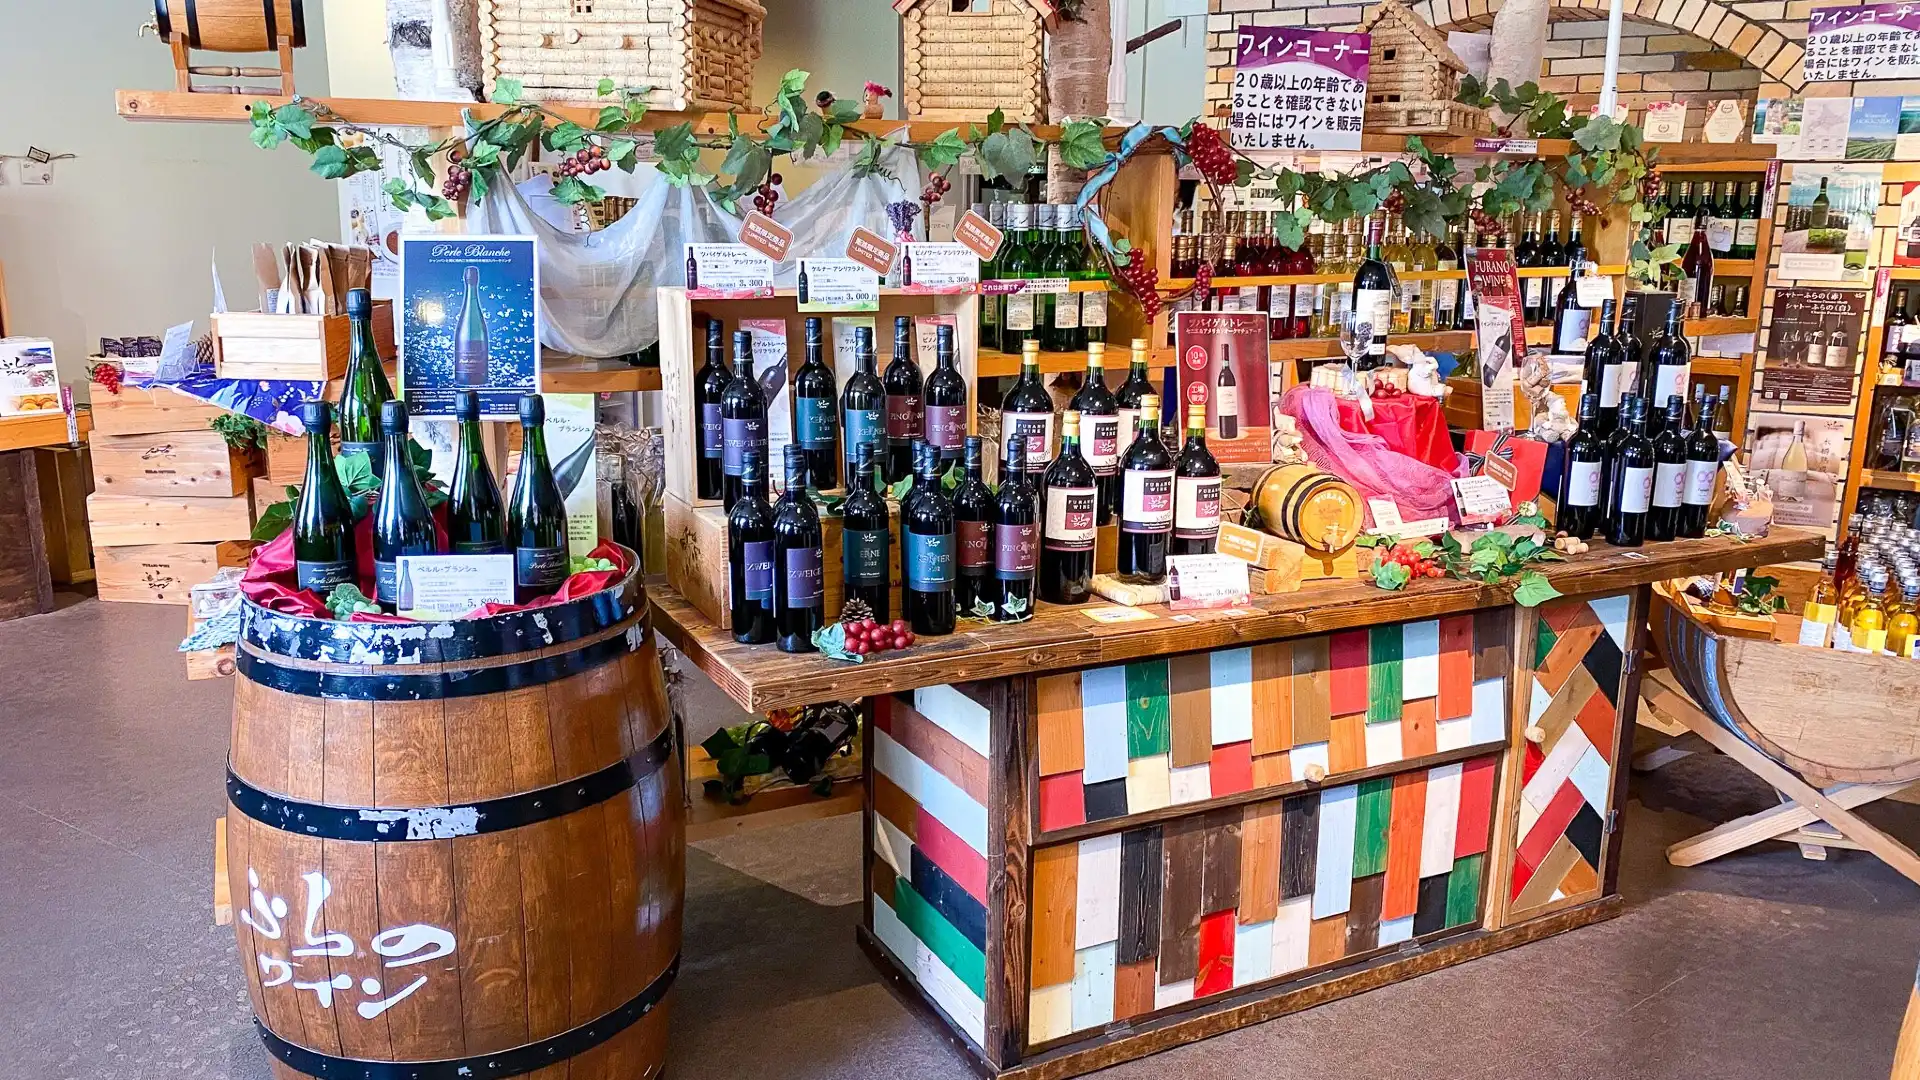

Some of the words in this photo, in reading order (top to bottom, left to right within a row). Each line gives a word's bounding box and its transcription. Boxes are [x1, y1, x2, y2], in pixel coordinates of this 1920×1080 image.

[1811, 11, 1920, 26] ワインコーナー
[1238, 34, 1370, 62] ワインコーナー
[1803, 68, 1877, 80] いたしません。
[1233, 92, 1363, 112] ることを確認できない
[1230, 112, 1362, 132] 場合にはワインを販売
[1231, 132, 1315, 150] いたしません。
[431, 244, 461, 257] Perle
[464, 244, 511, 257] Blanche
[1474, 260, 1510, 273] FURANO
[1481, 274, 1507, 287] WINE
[258, 954, 428, 1020] ワイン
